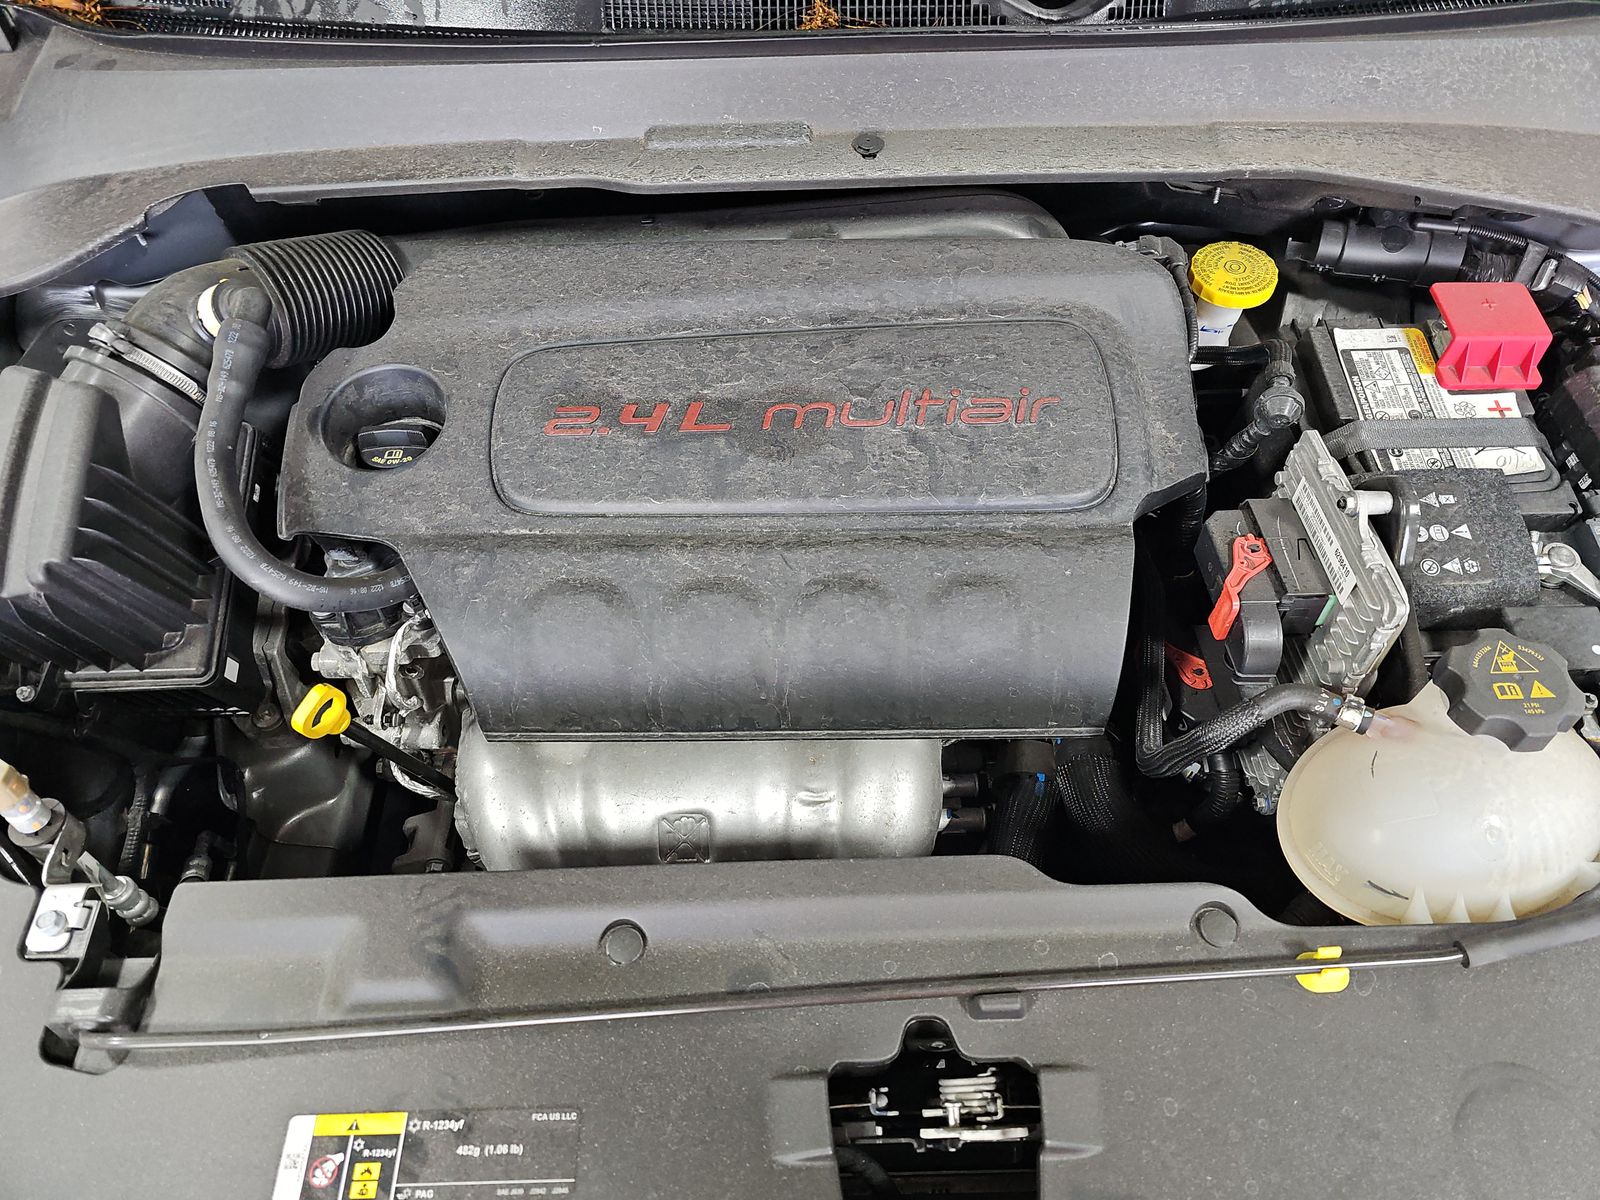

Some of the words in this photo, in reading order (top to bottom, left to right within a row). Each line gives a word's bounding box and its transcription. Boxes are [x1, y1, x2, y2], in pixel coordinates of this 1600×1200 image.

[1352, 375, 1373, 420] GER/POISON
[543, 402, 732, 436] 2.4L
[761, 387, 1062, 430] multiair
[371, 456, 386, 464] SAE
[531, 1113, 548, 1121] FCA
[561, 1112, 577, 1120] LLC
[422, 1119, 465, 1132] R-1234yf
[362, 1148, 397, 1158] R-1234yf
[456, 1145, 480, 1158] 482g
[484, 1144, 508, 1157] (1.06
[510, 1144, 523, 1156] lb)
[415, 1189, 434, 1198] PAG
